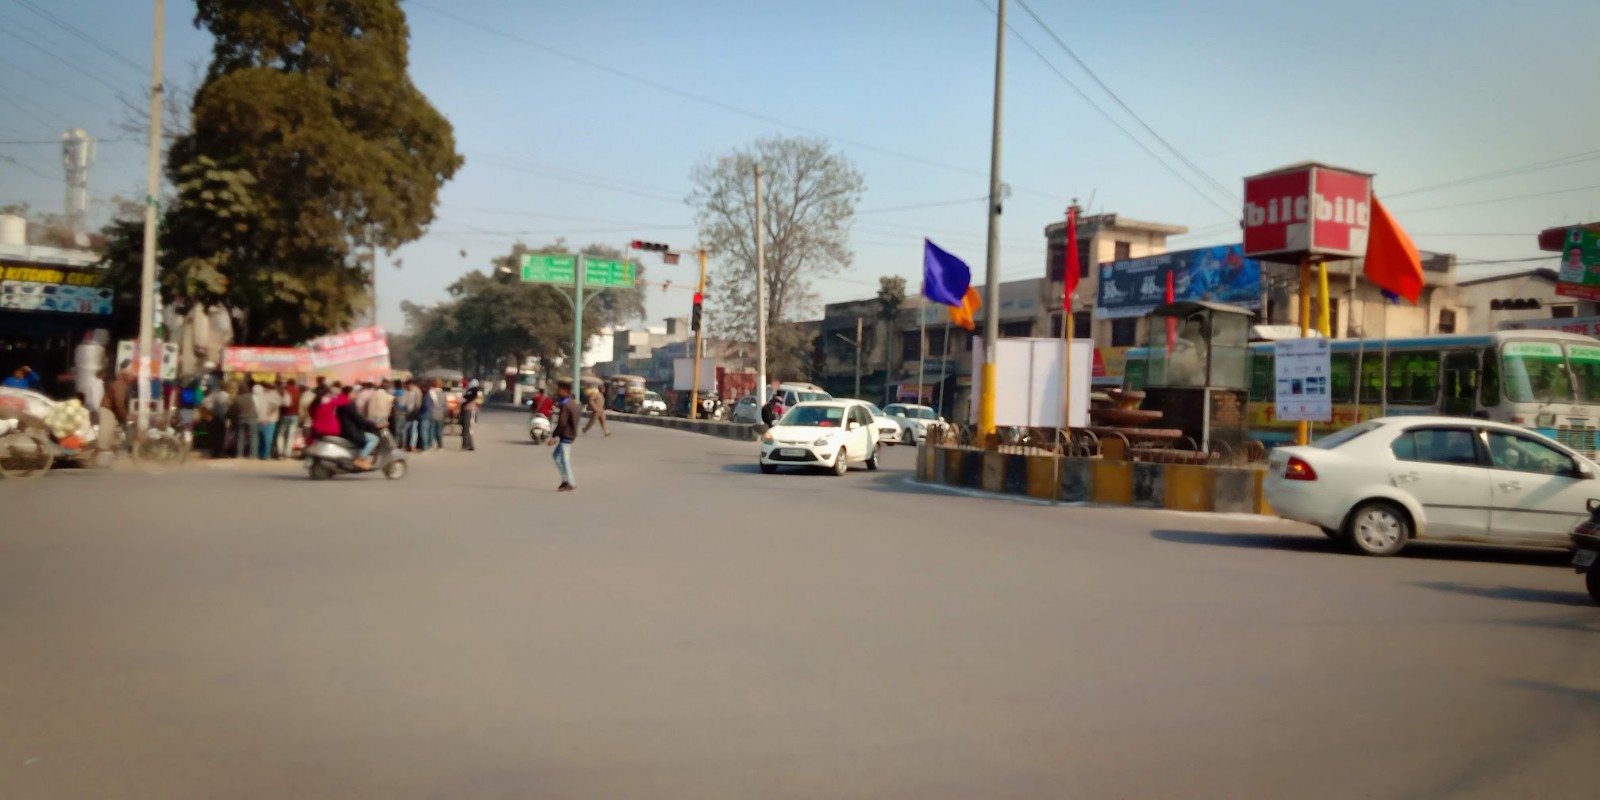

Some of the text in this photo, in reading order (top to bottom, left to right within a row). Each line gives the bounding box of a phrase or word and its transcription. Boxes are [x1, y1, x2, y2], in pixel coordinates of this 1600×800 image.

[1246, 196, 1308, 227] bilt
[1314, 192, 1368, 226] bilt
[6, 267, 62, 283] KITCHEN
